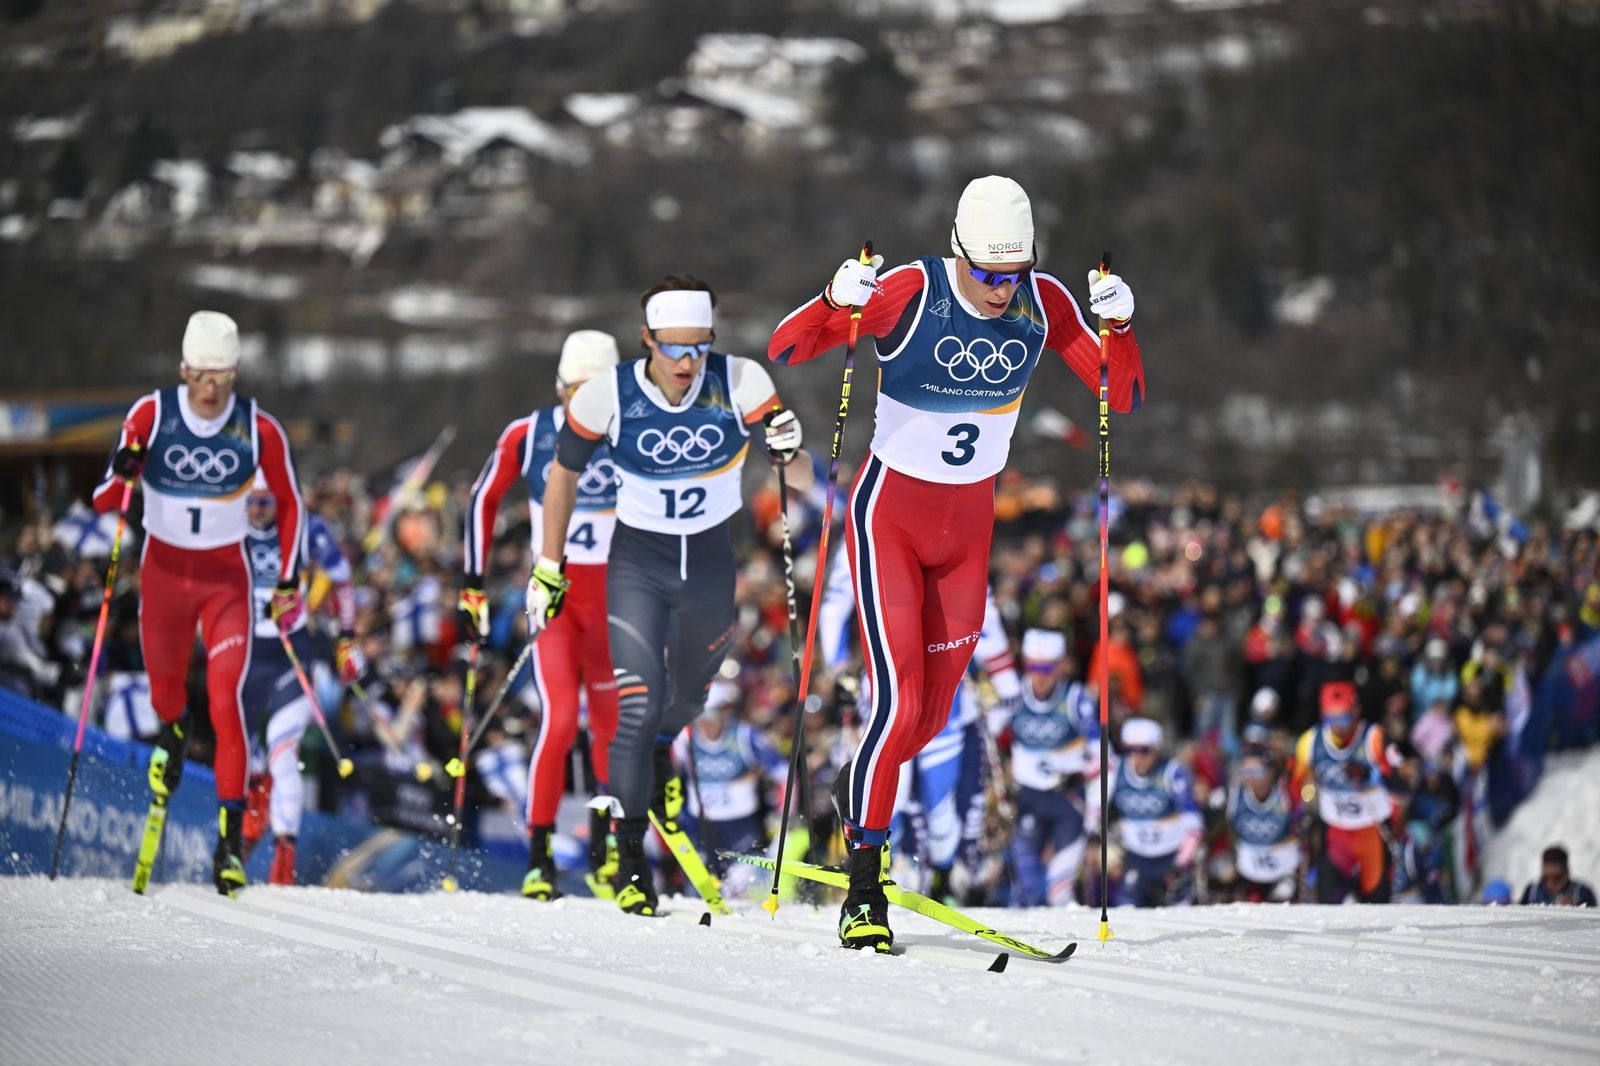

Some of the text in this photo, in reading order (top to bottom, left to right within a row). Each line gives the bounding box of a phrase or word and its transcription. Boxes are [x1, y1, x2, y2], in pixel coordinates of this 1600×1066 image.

[988, 241, 1024, 250] NORGE
[838, 367, 854, 417] LEKI
[920, 383, 963, 396] MILANO
[964, 388, 1005, 397] CORTINA
[1099, 386, 1108, 436] LEKI
[941, 423, 980, 466] 3
[659, 486, 707, 519] 12
[186, 507, 201, 534] 1
[569, 522, 597, 549] 4
[928, 635, 972, 653] CRAFT
